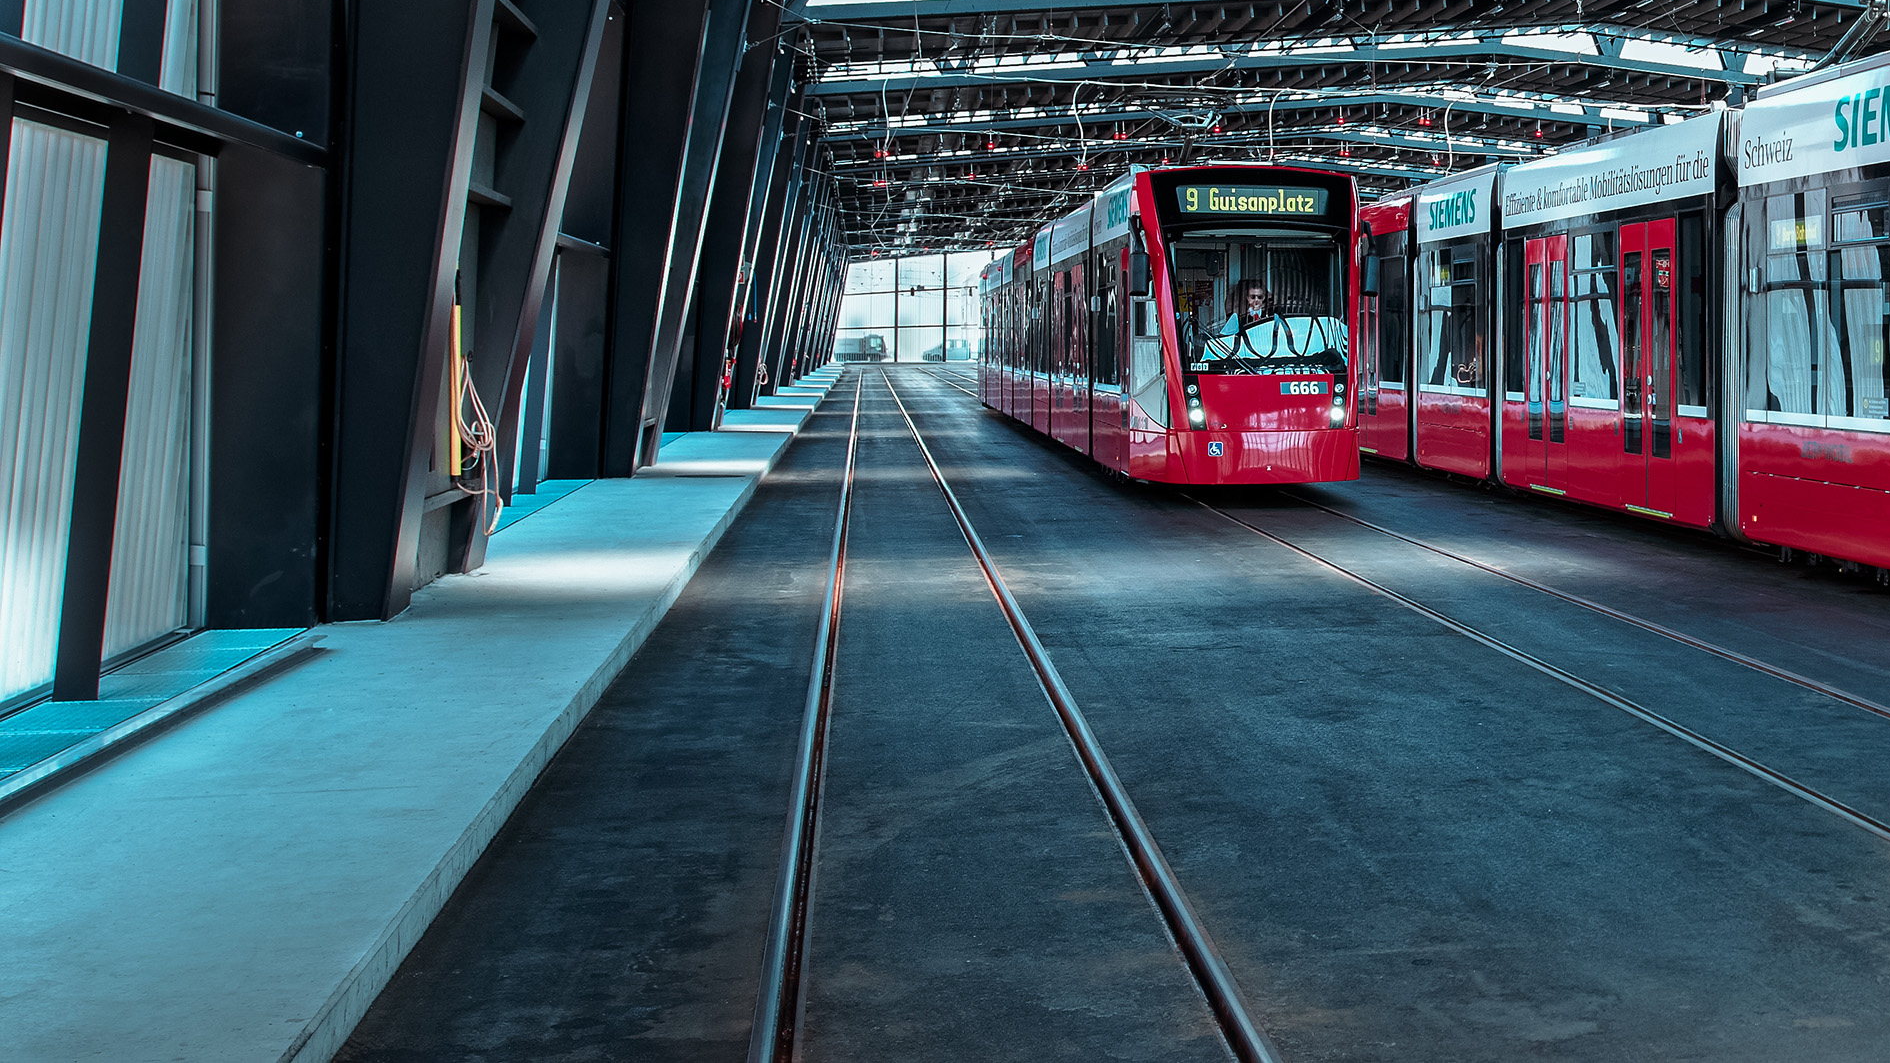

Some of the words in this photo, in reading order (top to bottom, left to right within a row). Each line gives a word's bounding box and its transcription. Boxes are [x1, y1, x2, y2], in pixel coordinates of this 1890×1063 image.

[1743, 130, 1794, 170] Schweiz
[1505, 191, 1537, 217] Effiziente
[1537, 187, 1543, 211] &
[1543, 177, 1589, 210] komfortable
[1589, 164, 1674, 201] Mobilitätslösungen
[1675, 154, 1692, 184] für
[1692, 149, 1710, 181] die
[1186, 188, 1199, 212] 9
[1209, 187, 1315, 214] Guisanplatz
[1429, 188, 1477, 231] SIEMENS
[1874, 339, 1881, 363] 9
[1289, 381, 1320, 395] 666
